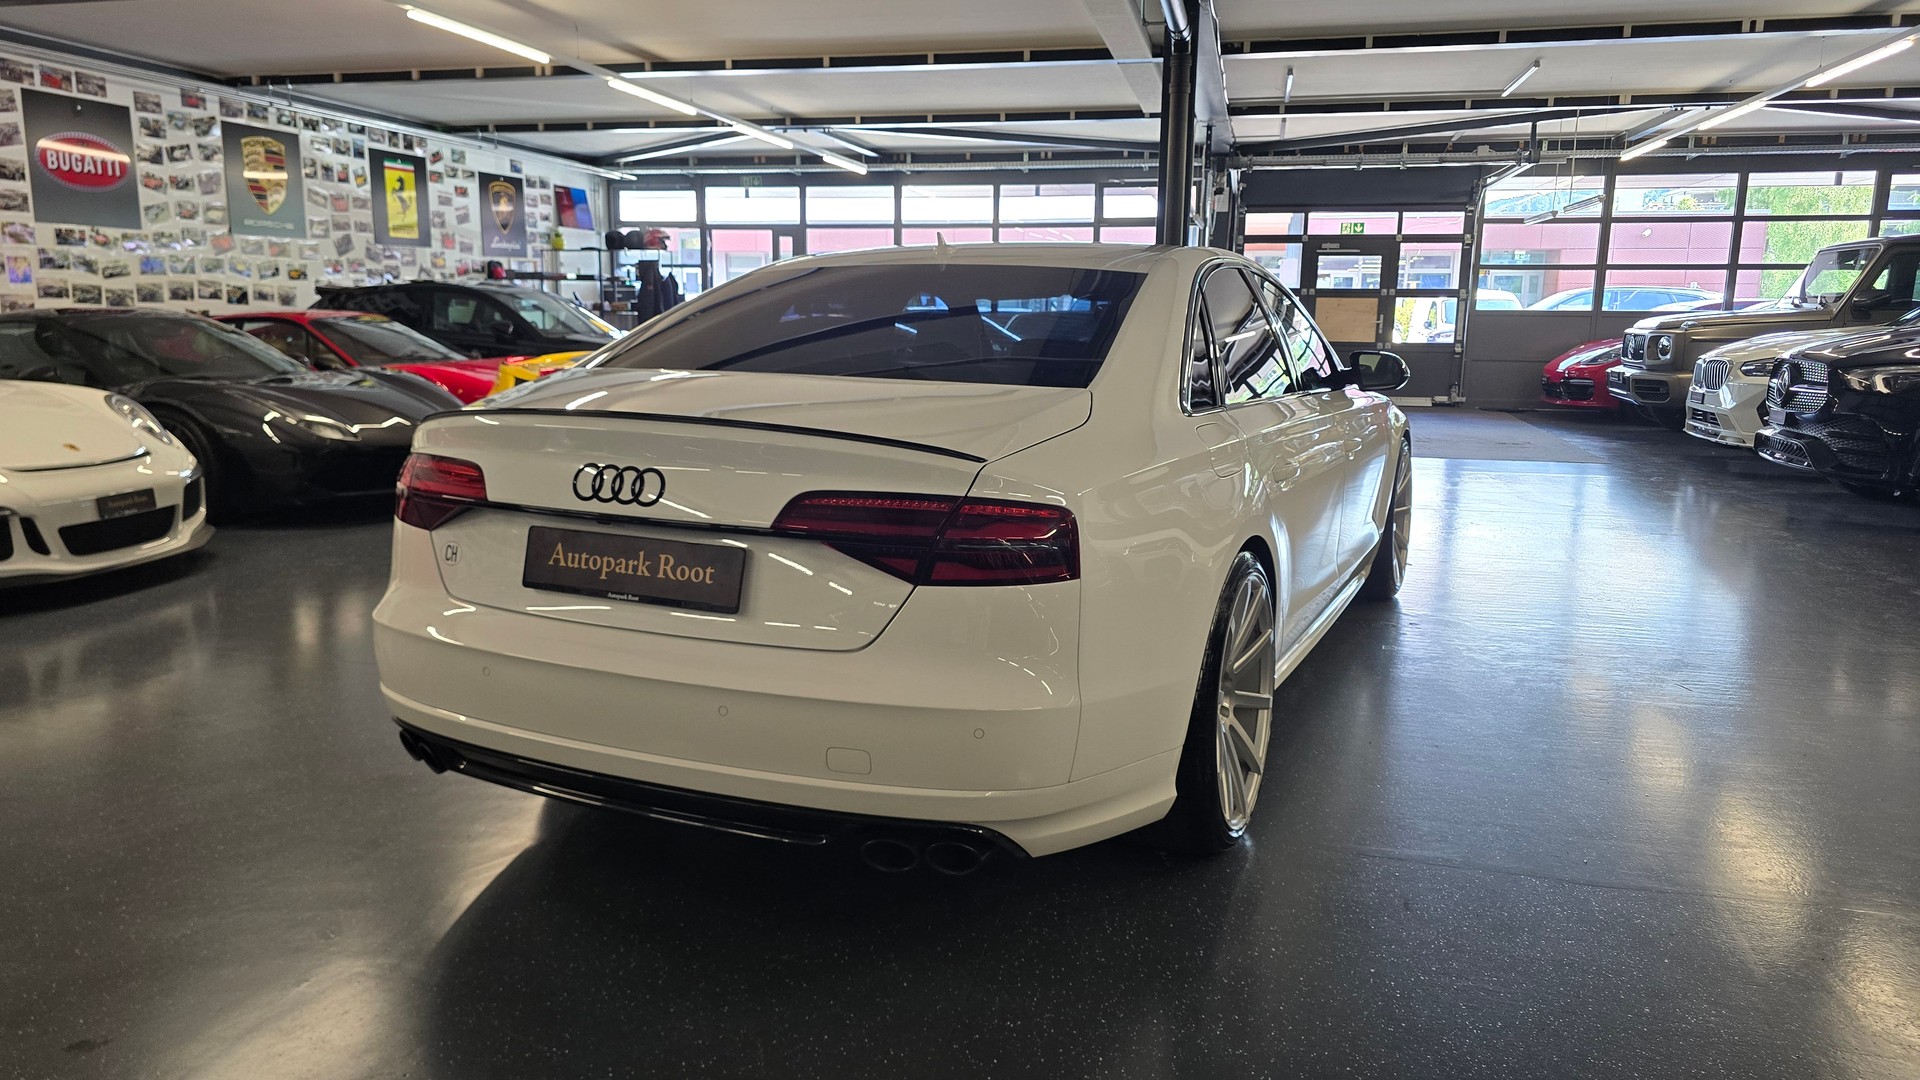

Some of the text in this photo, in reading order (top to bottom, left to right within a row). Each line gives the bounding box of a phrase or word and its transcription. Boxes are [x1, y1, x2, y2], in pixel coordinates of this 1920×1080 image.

[46, 149, 121, 177] BUGATTI
[445, 544, 459, 563] CH
[548, 542, 715, 584] Autopark Root
